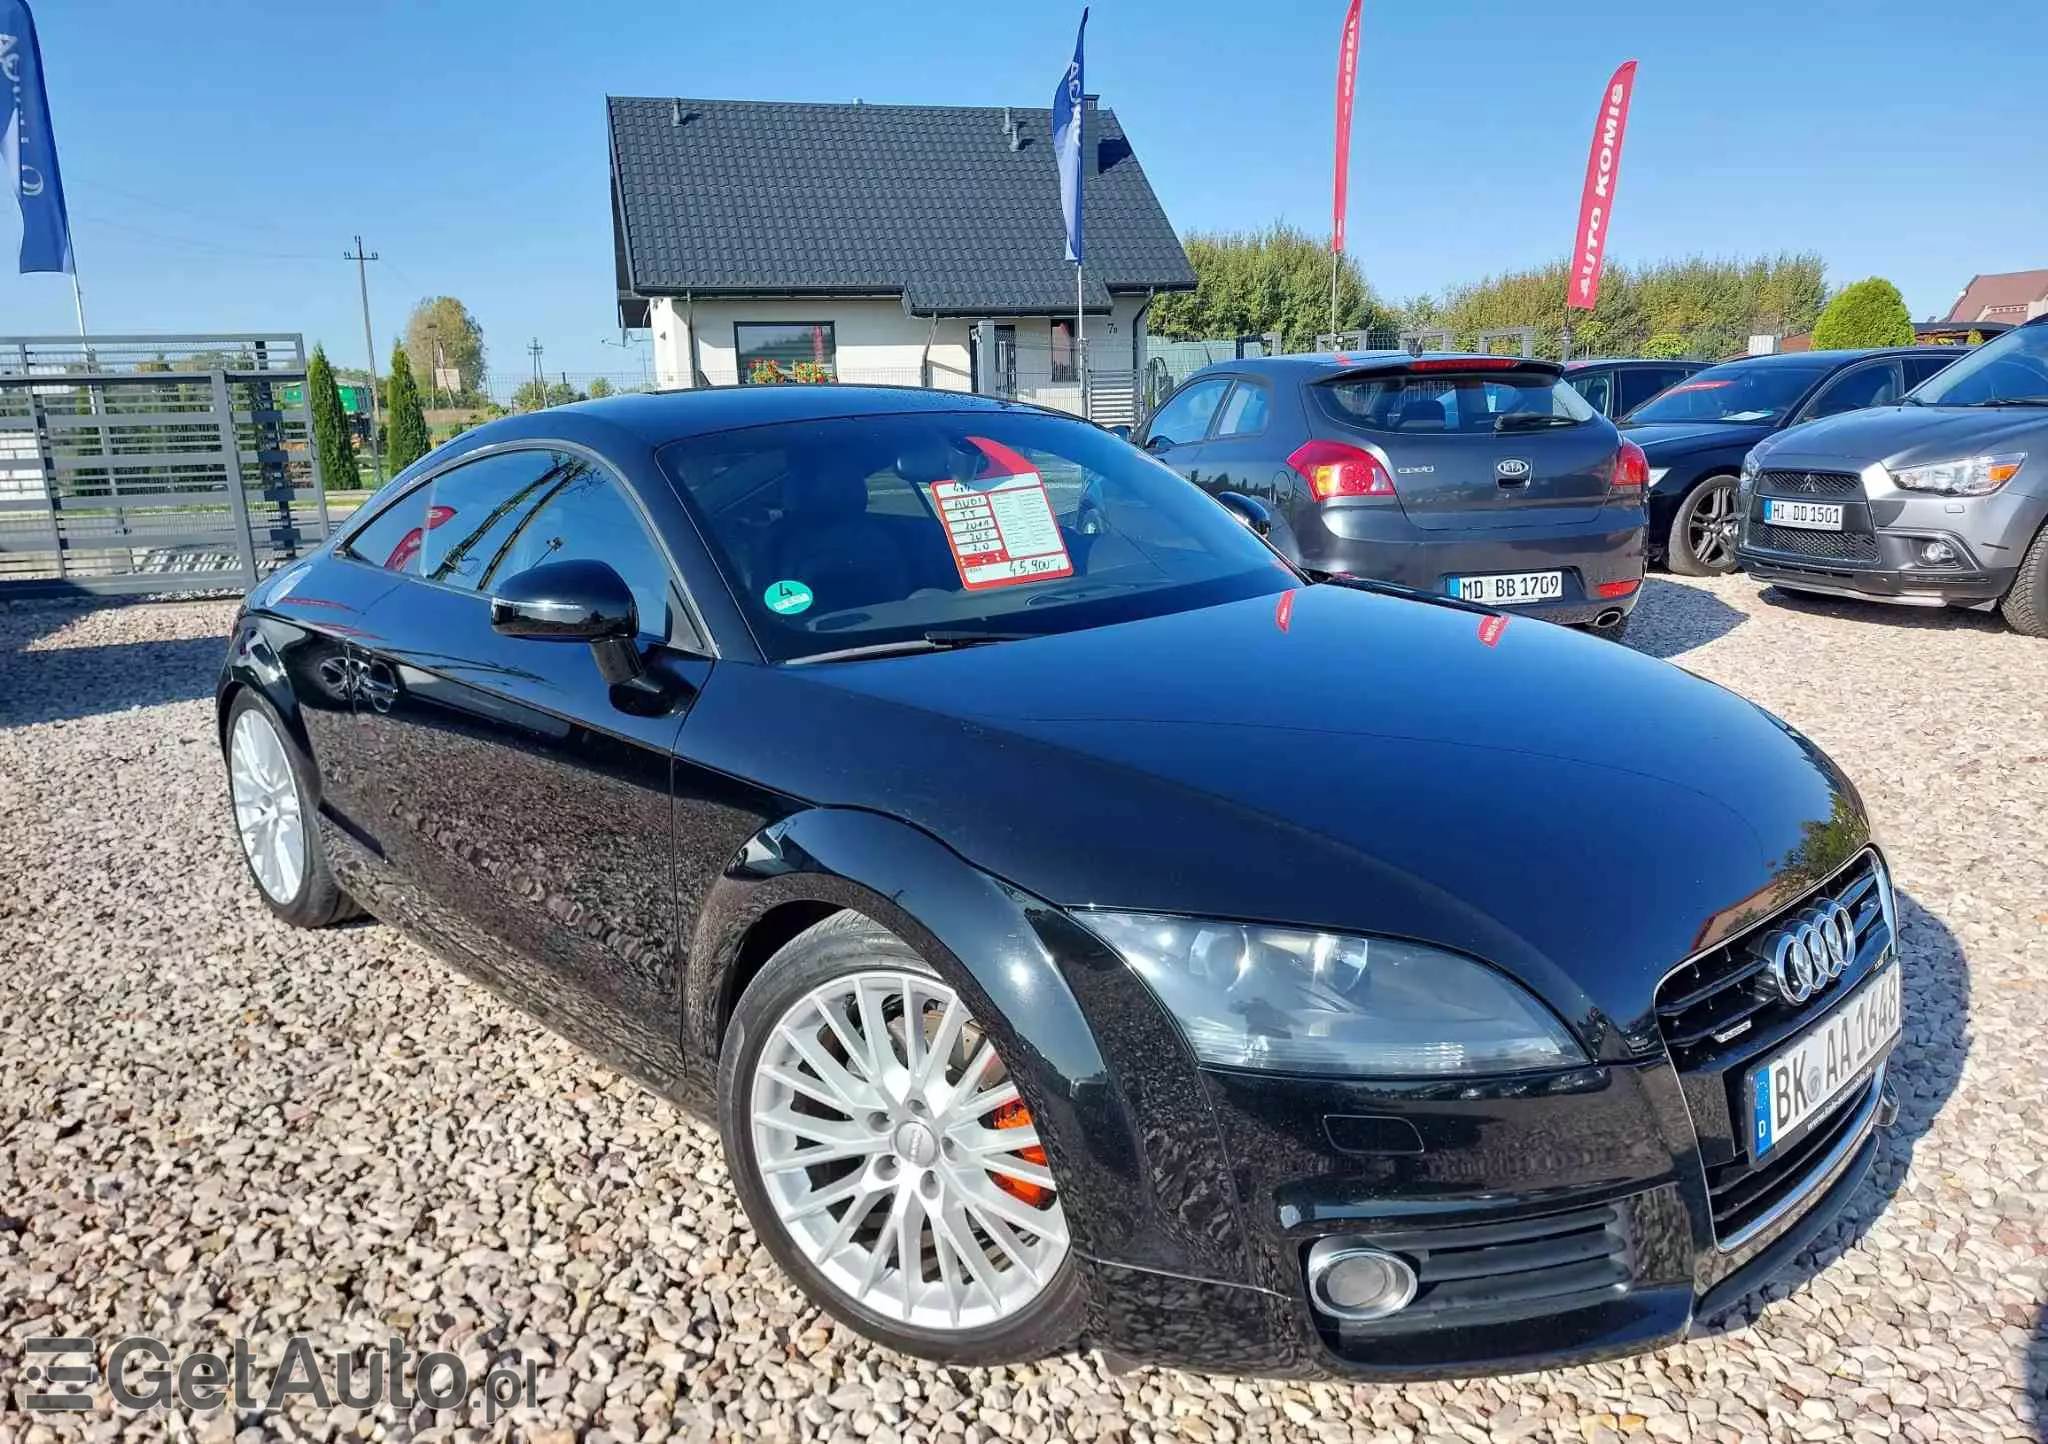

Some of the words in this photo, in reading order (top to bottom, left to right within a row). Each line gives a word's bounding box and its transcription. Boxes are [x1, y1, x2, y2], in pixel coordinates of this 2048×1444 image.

[1579, 207, 1602, 299] AUTO
[1595, 83, 1624, 198] KOMIS
[1773, 503, 1785, 520] HI
[1793, 504, 1808, 521] DD
[1810, 505, 1840, 524] 1501
[779, 582, 793, 597] 4
[1462, 580, 1484, 600] MD
[1496, 578, 1516, 598] BB
[1520, 575, 1559, 596] 1709
[1775, 1049, 1808, 1131] BK
[1825, 1017, 1851, 1090] AA
[1855, 973, 1898, 1062] 1648
